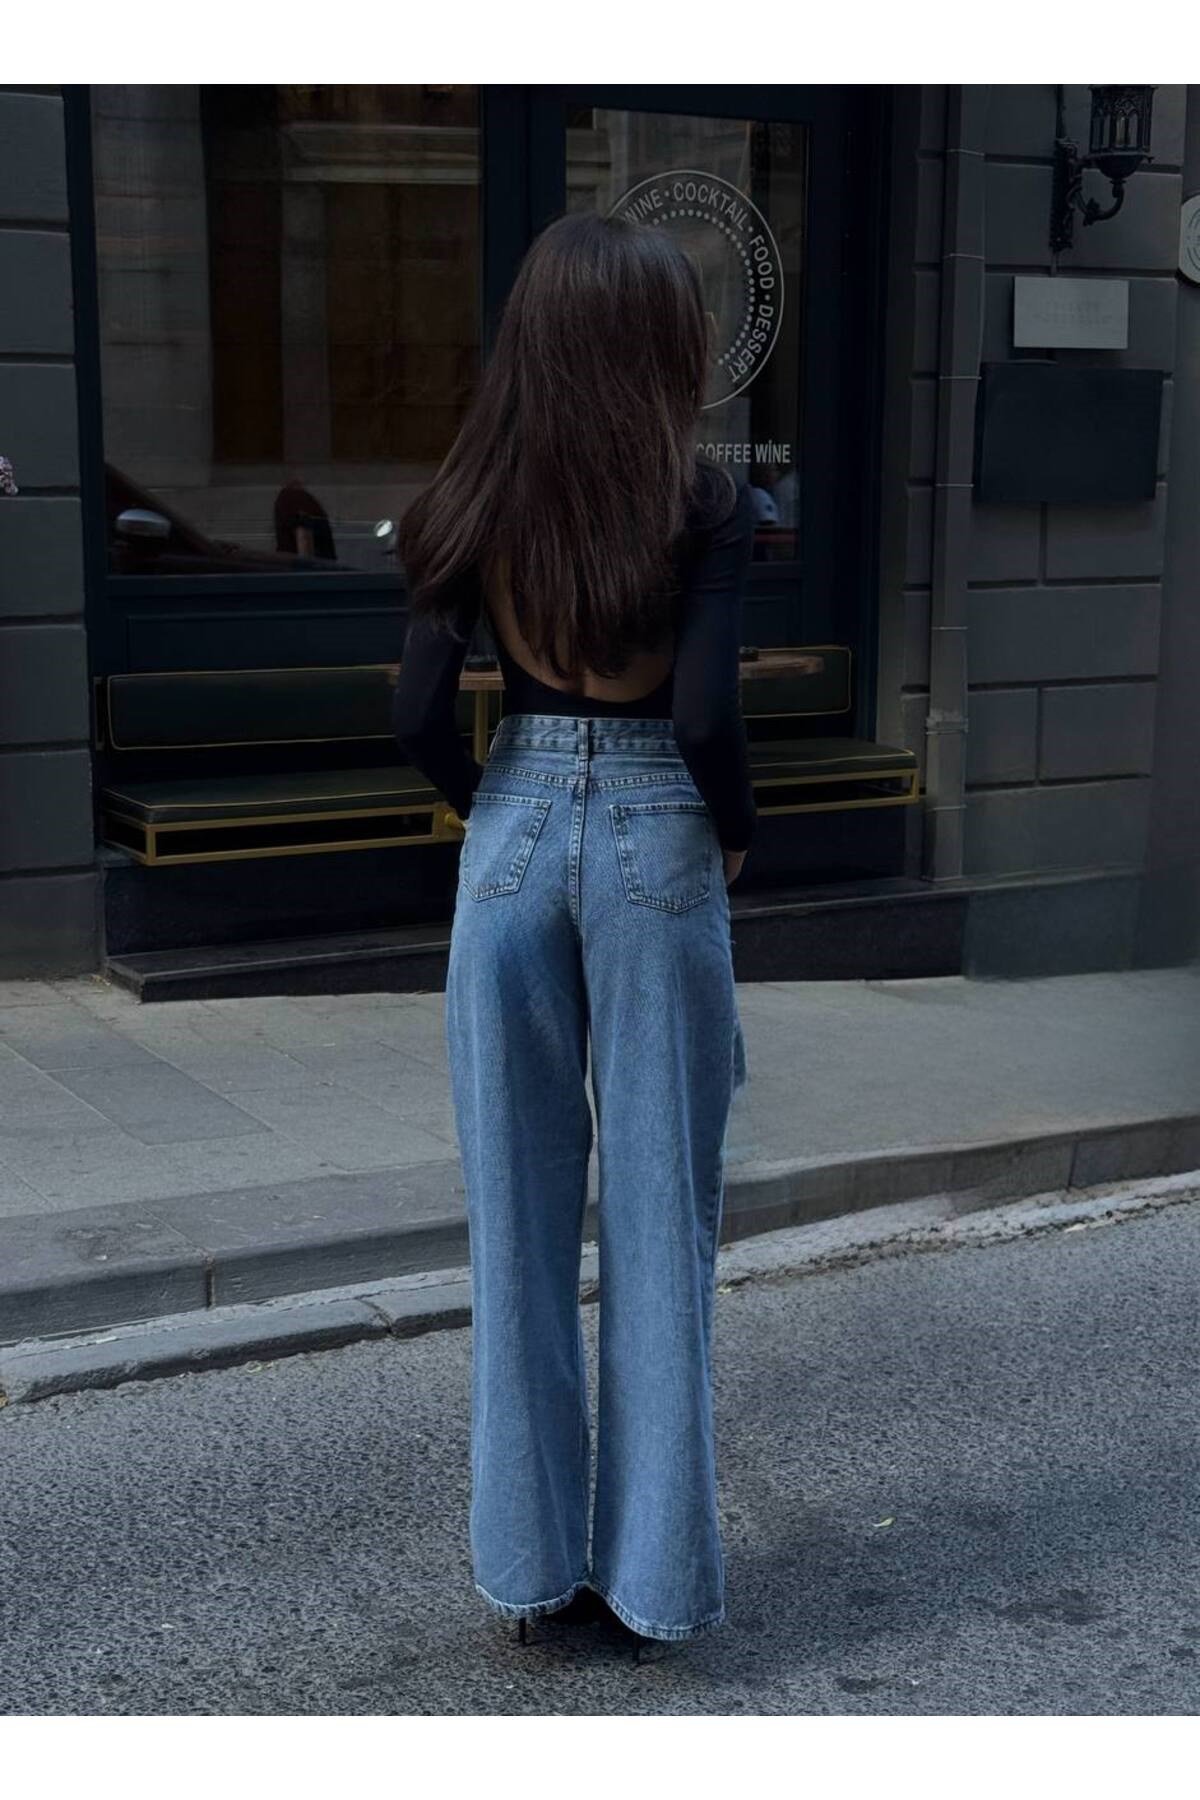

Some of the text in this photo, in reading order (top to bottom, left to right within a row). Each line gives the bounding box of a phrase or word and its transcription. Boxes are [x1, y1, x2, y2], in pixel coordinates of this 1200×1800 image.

[673, 182, 749, 231] COCKTAIL
[749, 235, 775, 290] FOOD
[728, 304, 774, 383] DESSERT
